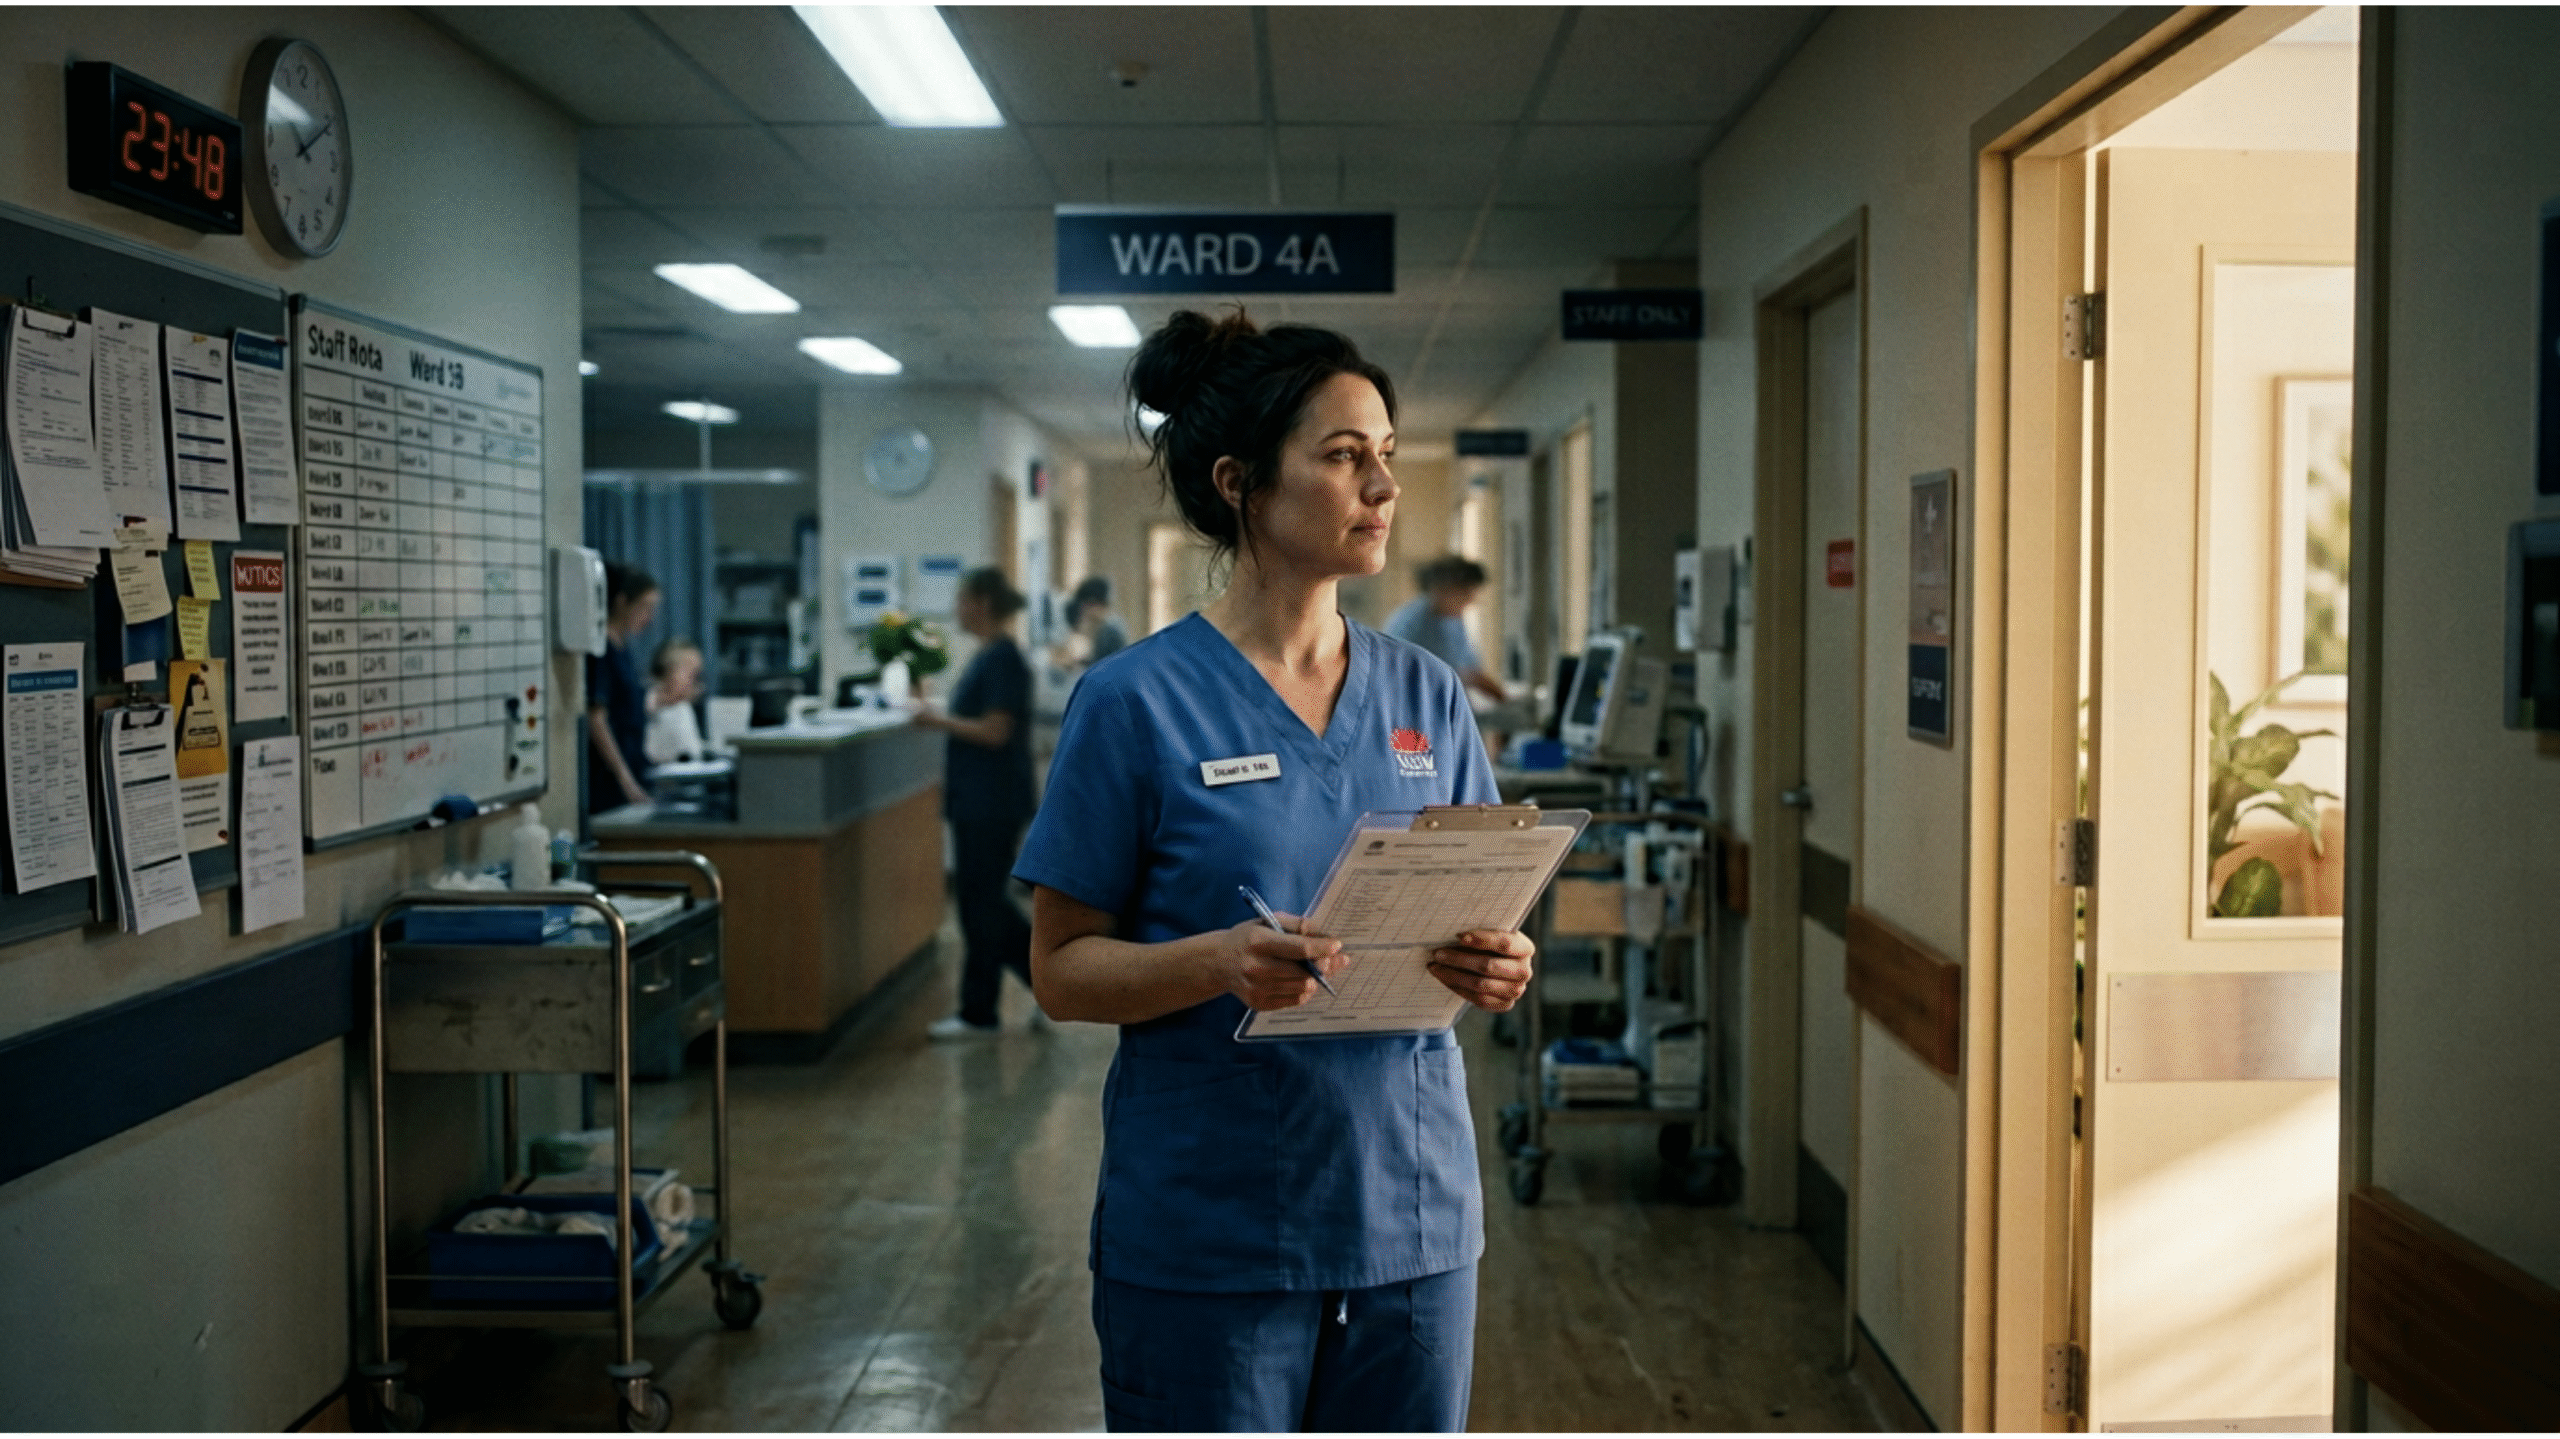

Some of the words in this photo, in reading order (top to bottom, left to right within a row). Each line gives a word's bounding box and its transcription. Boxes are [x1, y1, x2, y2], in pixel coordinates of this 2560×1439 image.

[121, 100, 227, 201] 23:48
[1109, 233, 1263, 276] WARD
[1274, 233, 1341, 275] 4A
[1636, 304, 1692, 325] ONLY
[308, 323, 346, 362] Staff
[349, 335, 383, 372] Rota
